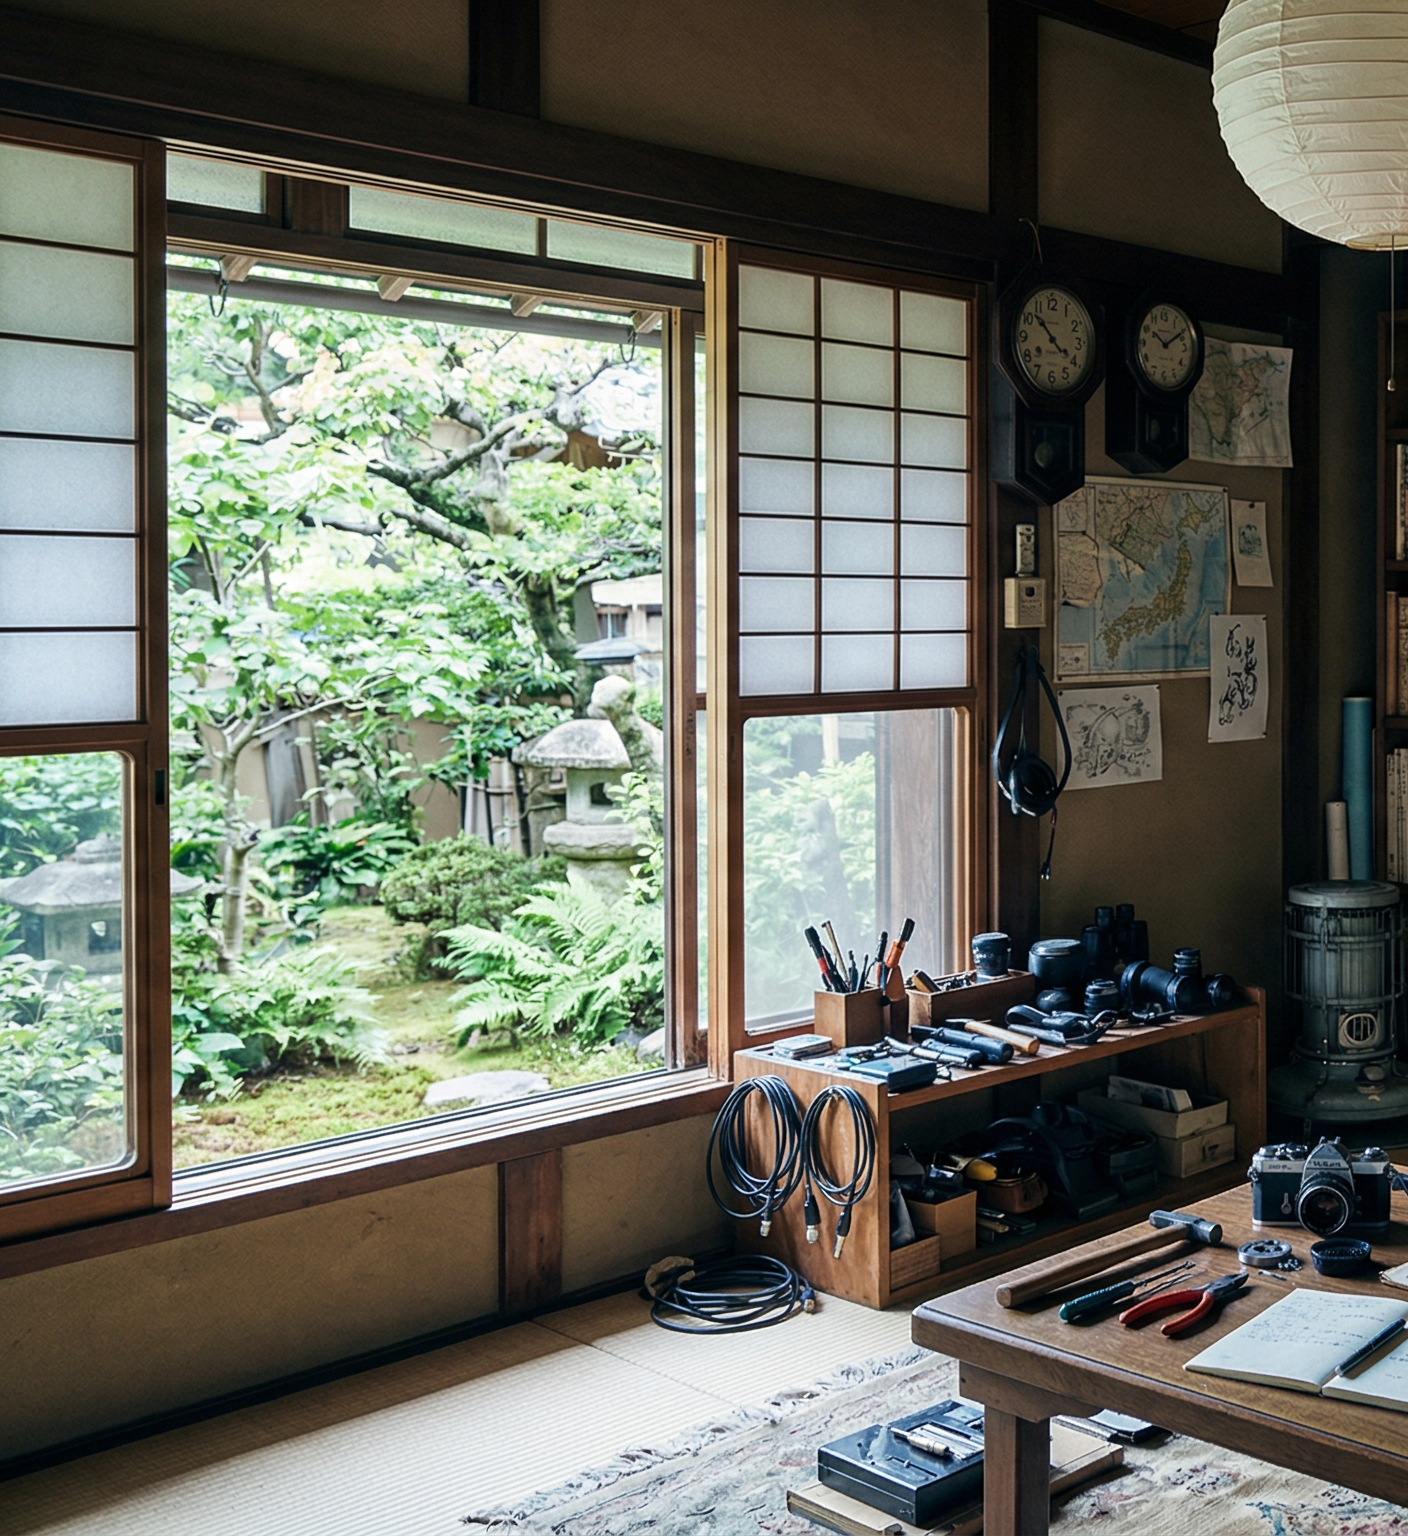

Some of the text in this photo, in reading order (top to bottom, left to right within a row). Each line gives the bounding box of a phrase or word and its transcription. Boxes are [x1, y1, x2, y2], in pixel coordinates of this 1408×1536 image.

[1035, 300, 1042, 313] 11
[1047, 297, 1058, 311] 12
[1023, 312, 1033, 325] 10
[1071, 319, 1079, 332] 2
[1019, 330, 1028, 342] 9
[1075, 337, 1082, 350] 3
[1023, 349, 1032, 363] 8
[1070, 355, 1077, 367] 4
[1034, 364, 1041, 379] 7
[1048, 371, 1056, 384] 6
[1062, 367, 1070, 380] 5
